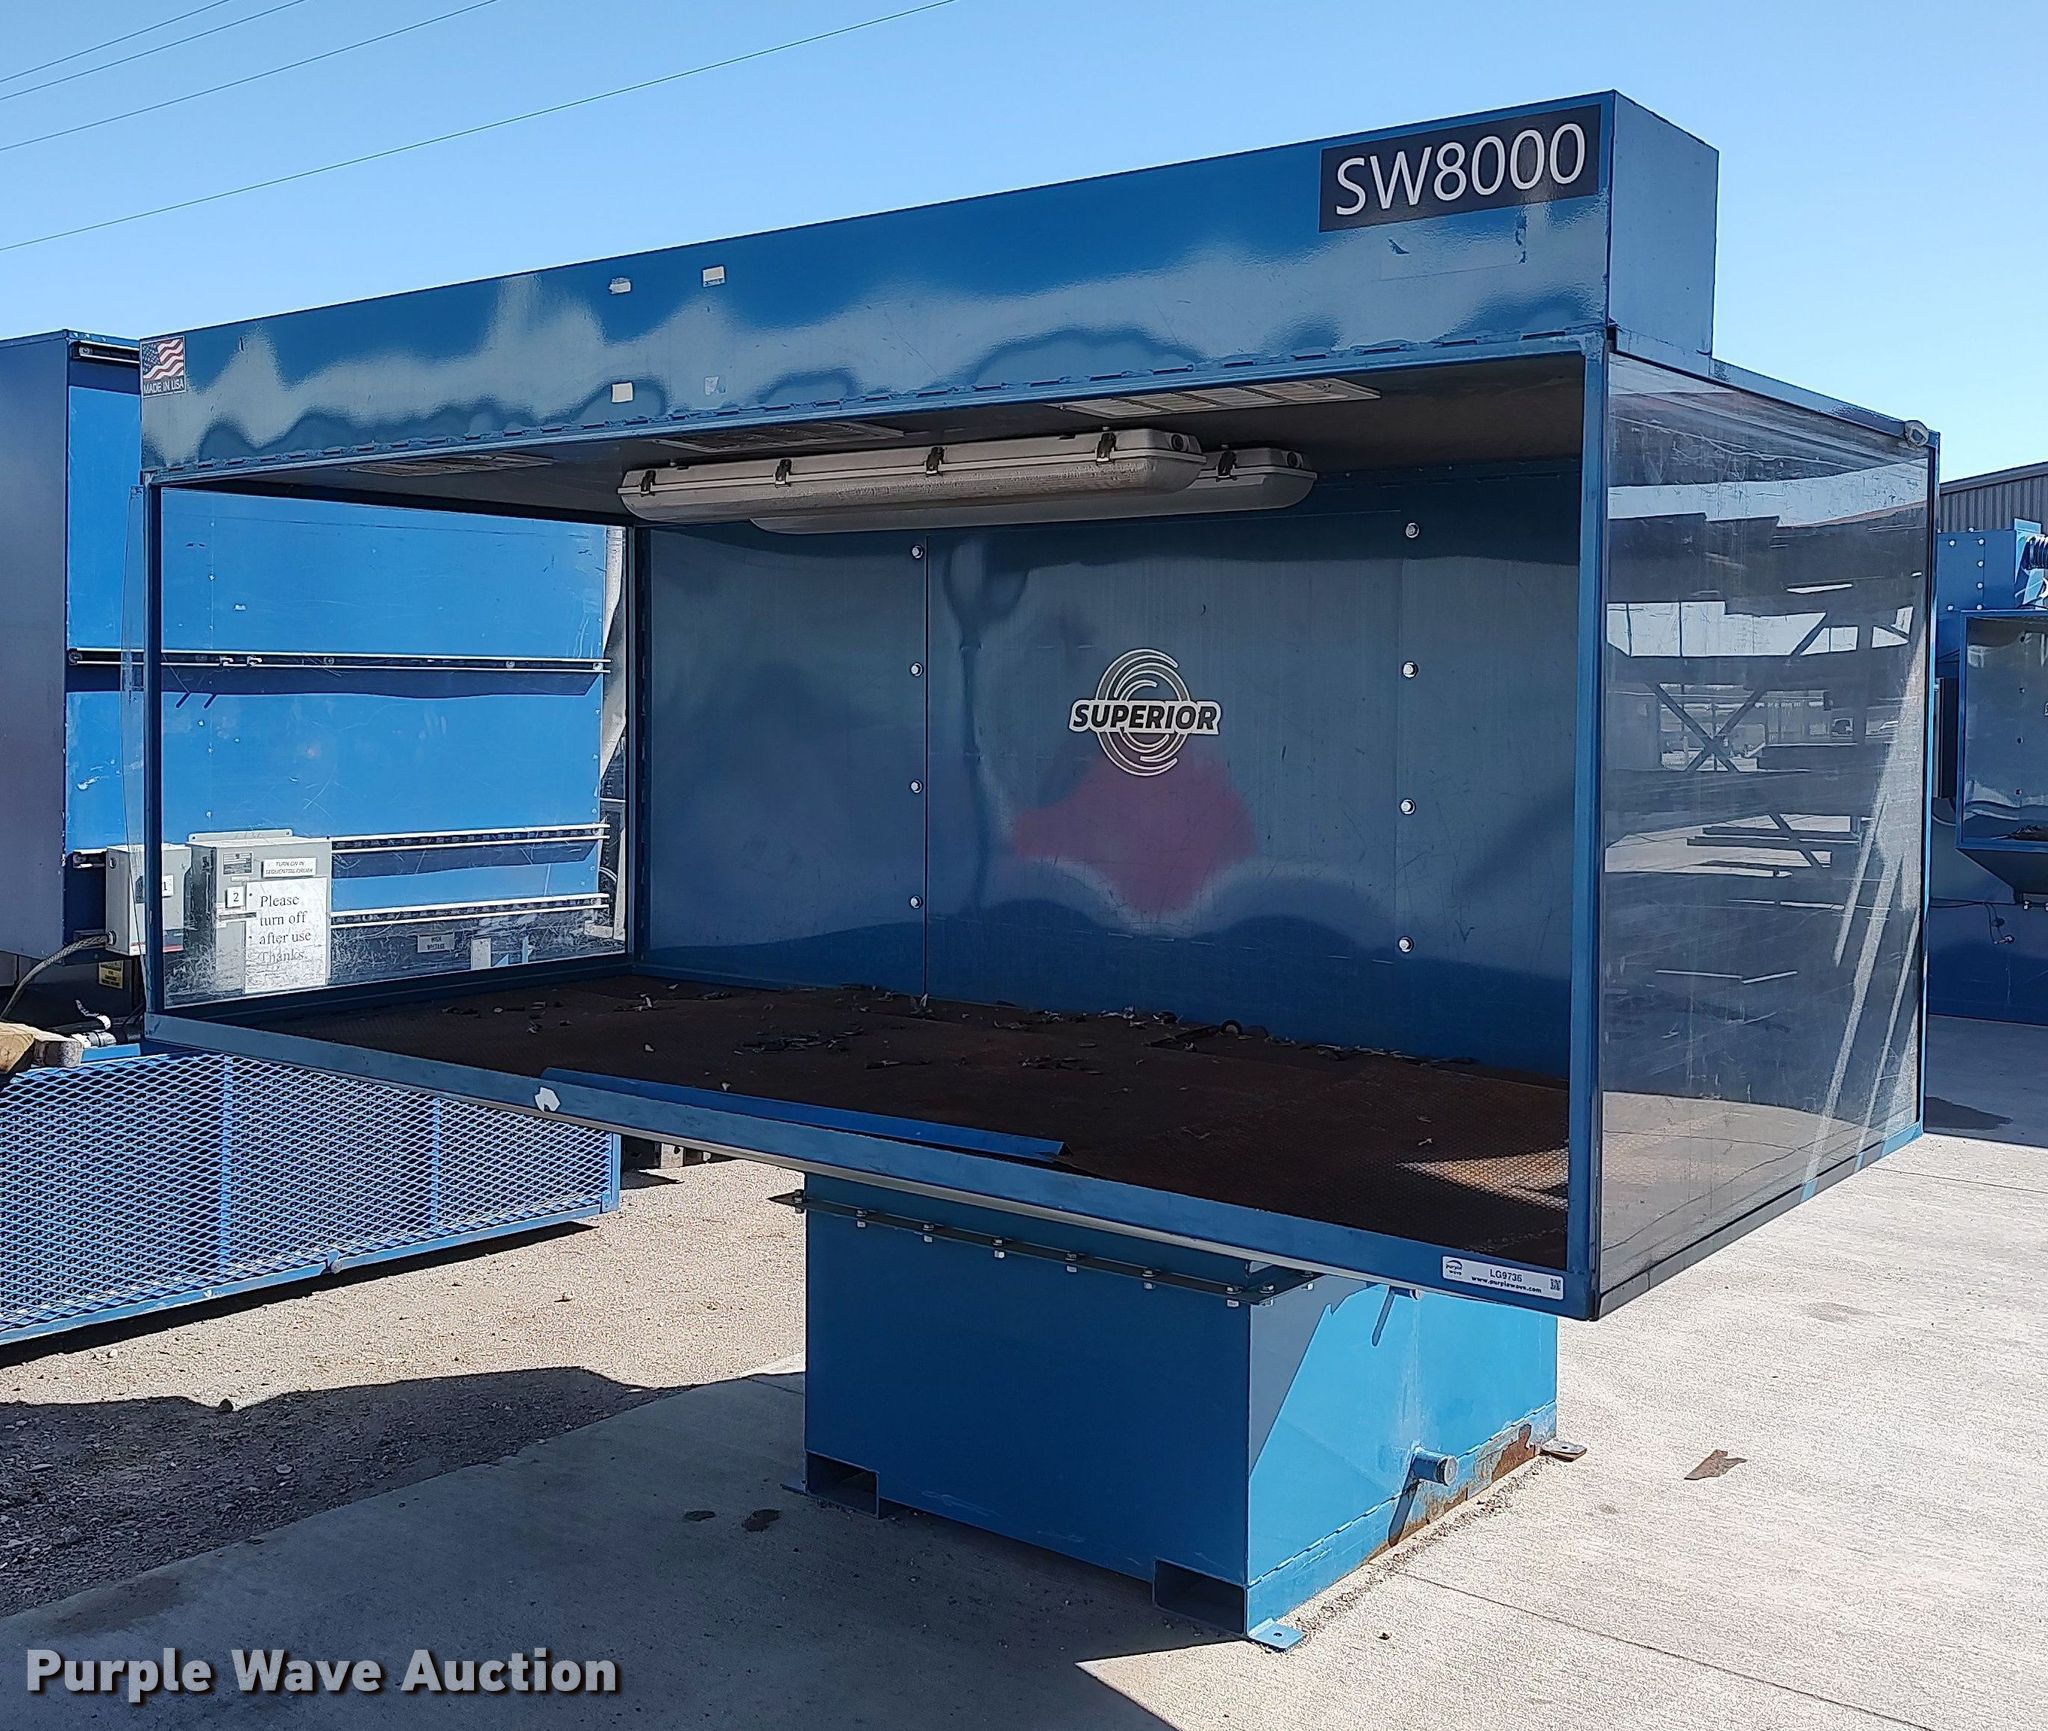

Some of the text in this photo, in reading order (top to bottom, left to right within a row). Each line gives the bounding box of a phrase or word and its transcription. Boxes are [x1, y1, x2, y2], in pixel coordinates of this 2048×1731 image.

[1335, 122, 1586, 216] SW8000
[143, 378, 184, 394] MADE IN USA
[1072, 702, 1218, 731] SUPERIOR
[232, 892, 239, 902] 2
[260, 895, 300, 908] Please
[260, 910, 308, 927] turn off
[259, 931, 312, 945] after use
[1471, 1276, 1542, 1294] www.purplewave.com
